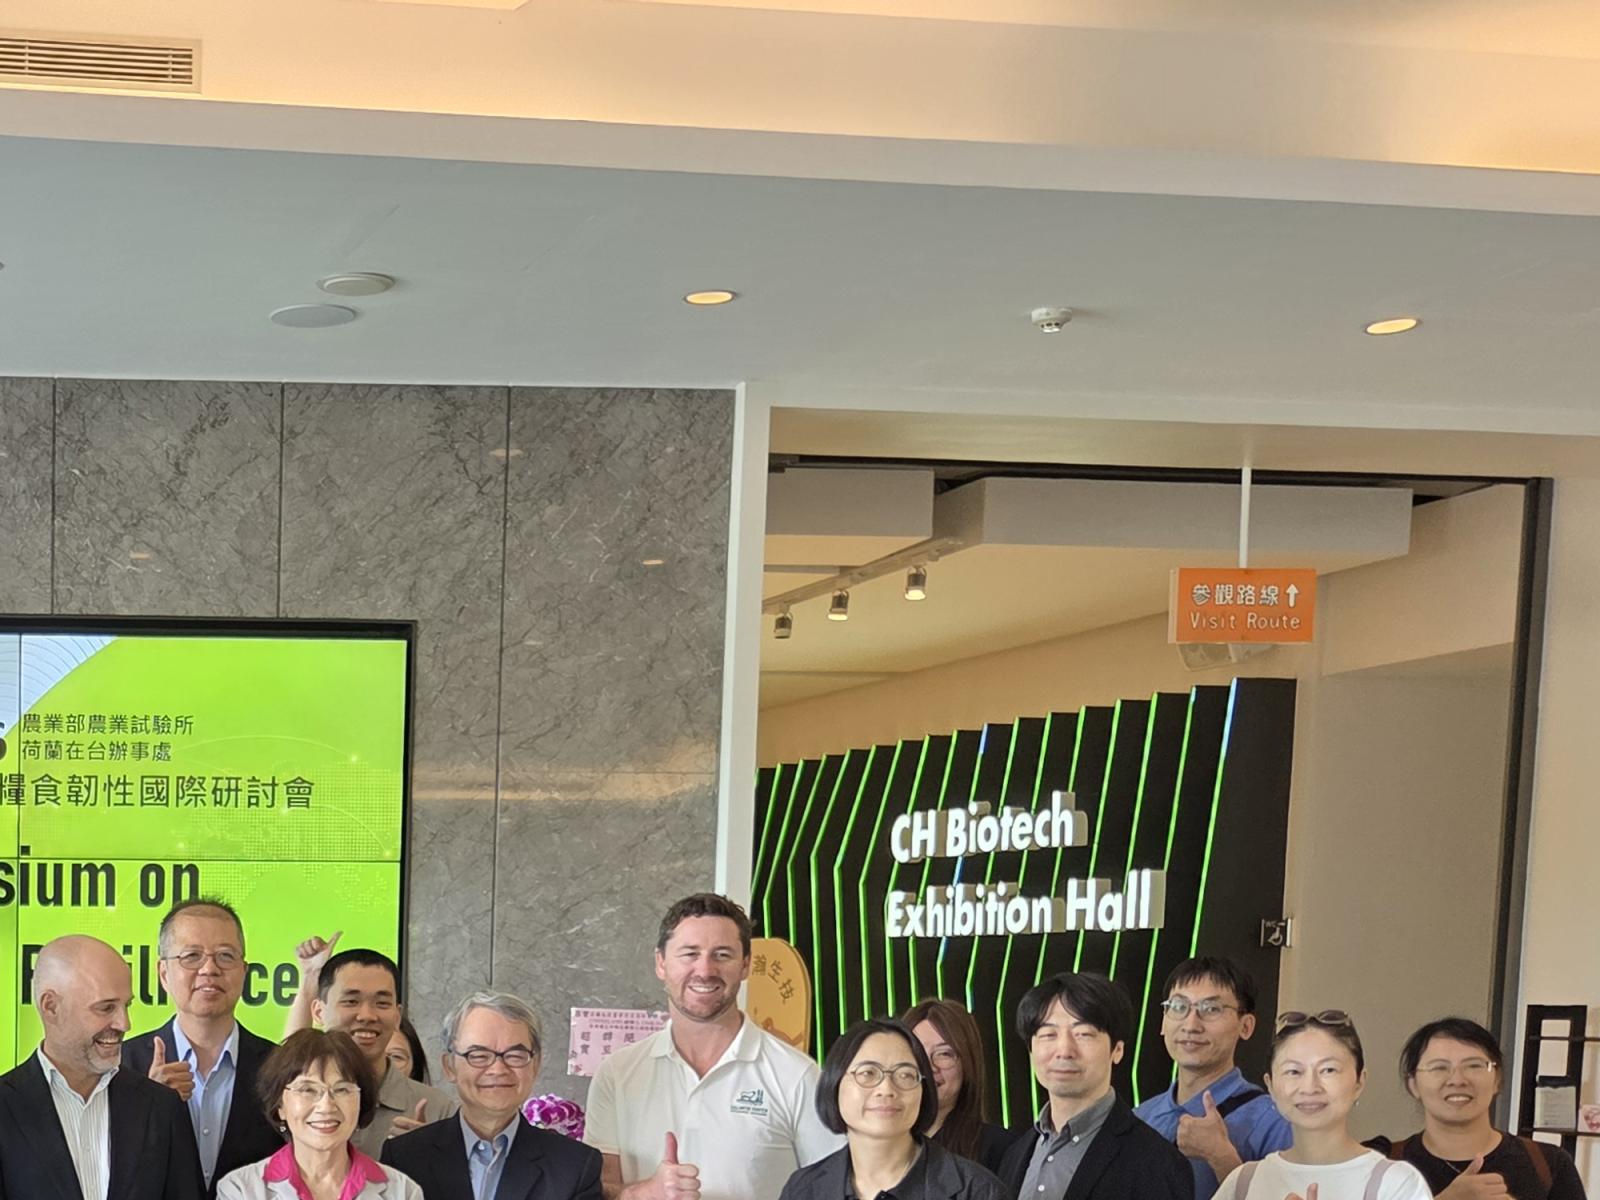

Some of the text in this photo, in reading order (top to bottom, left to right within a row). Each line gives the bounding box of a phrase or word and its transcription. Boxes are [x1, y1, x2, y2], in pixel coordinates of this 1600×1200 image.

[1192, 584, 1279, 606] 參觀路線
[1190, 612, 1300, 629] Visit Route
[22, 714, 194, 735] 農業部農業試驗所
[22, 740, 172, 762] 荷蘭在台辦事處
[890, 790, 1080, 863] CH Biotech
[140, 862, 200, 906] on
[887, 868, 1156, 938] Exhibition Hall
